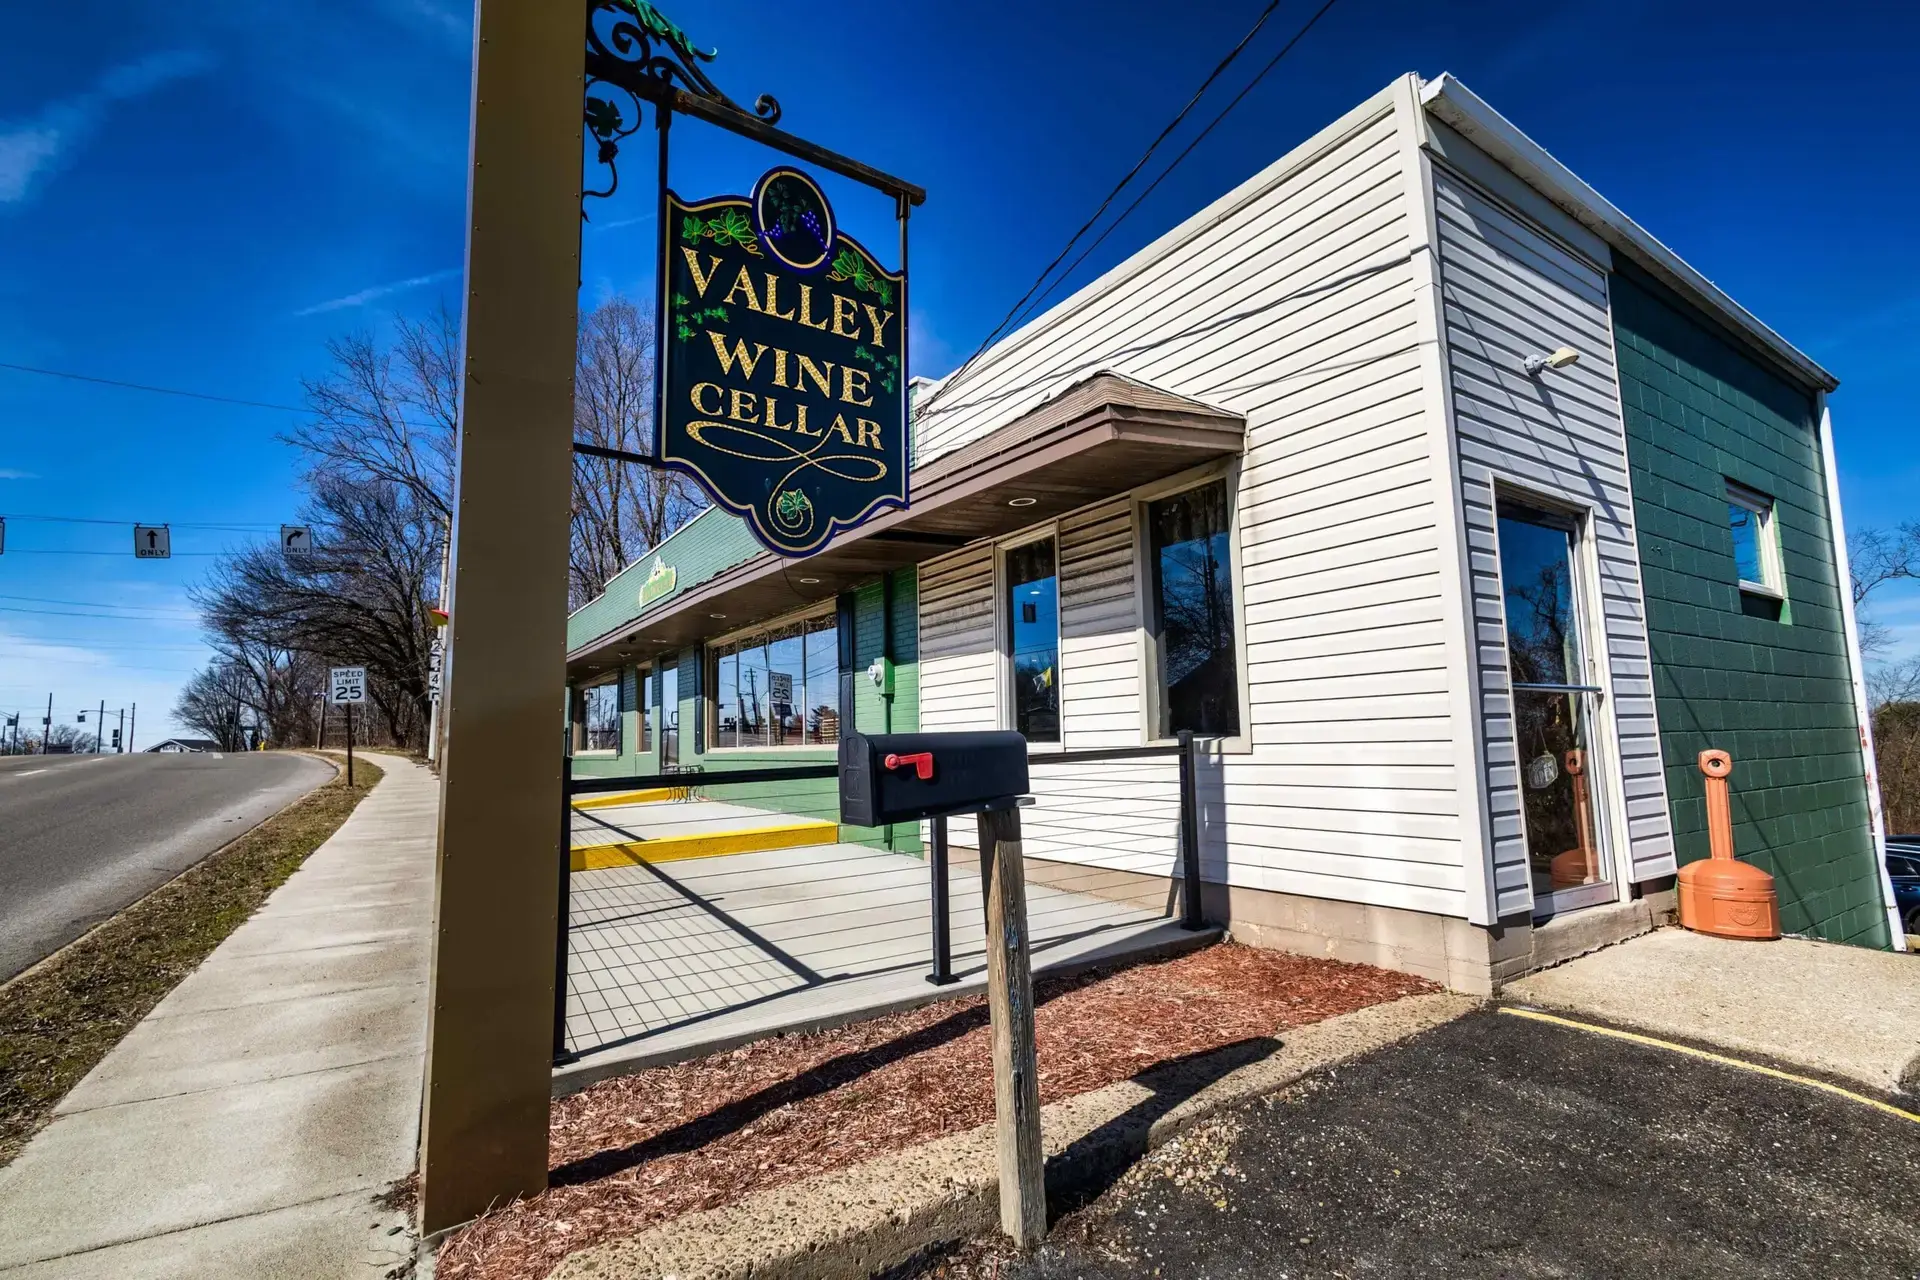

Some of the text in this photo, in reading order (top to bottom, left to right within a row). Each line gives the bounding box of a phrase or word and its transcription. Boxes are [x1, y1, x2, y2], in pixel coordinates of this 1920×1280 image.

[680, 245, 895, 349] VALLEY
[705, 329, 875, 408] WINE
[689, 381, 885, 452] CELLAR
[140, 548, 166, 556] ONLY
[333, 670, 363, 678] SPEED
[335, 686, 362, 700] 25
